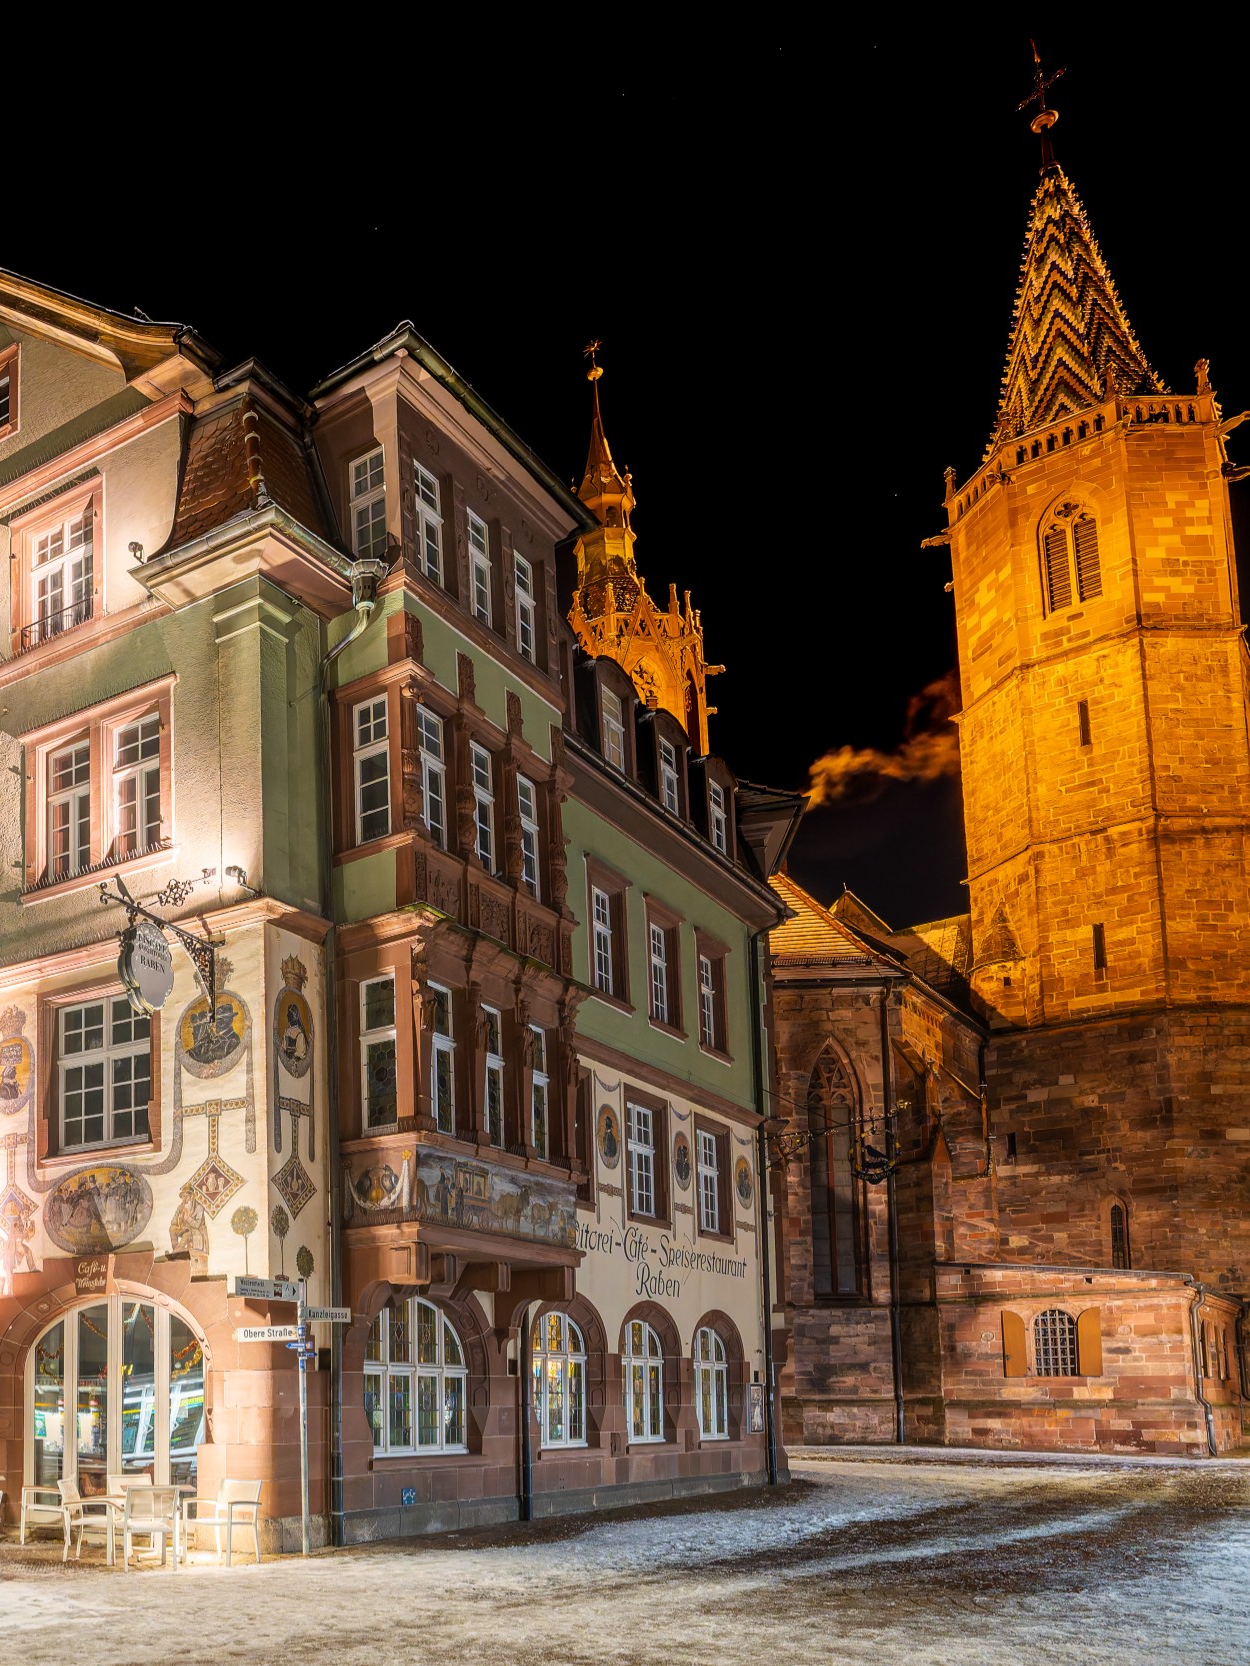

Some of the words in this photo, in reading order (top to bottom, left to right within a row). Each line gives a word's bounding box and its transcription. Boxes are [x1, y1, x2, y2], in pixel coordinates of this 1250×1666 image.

[140, 955, 165, 973] RABEN
[623, 1226, 649, 1262] Café
[659, 1234, 747, 1279] Speiserestaurant
[636, 1261, 680, 1298] Raben
[308, 1309, 348, 1320] Kanzleigasse
[243, 1329, 265, 1338] Obere
[267, 1327, 293, 1337] Straße
